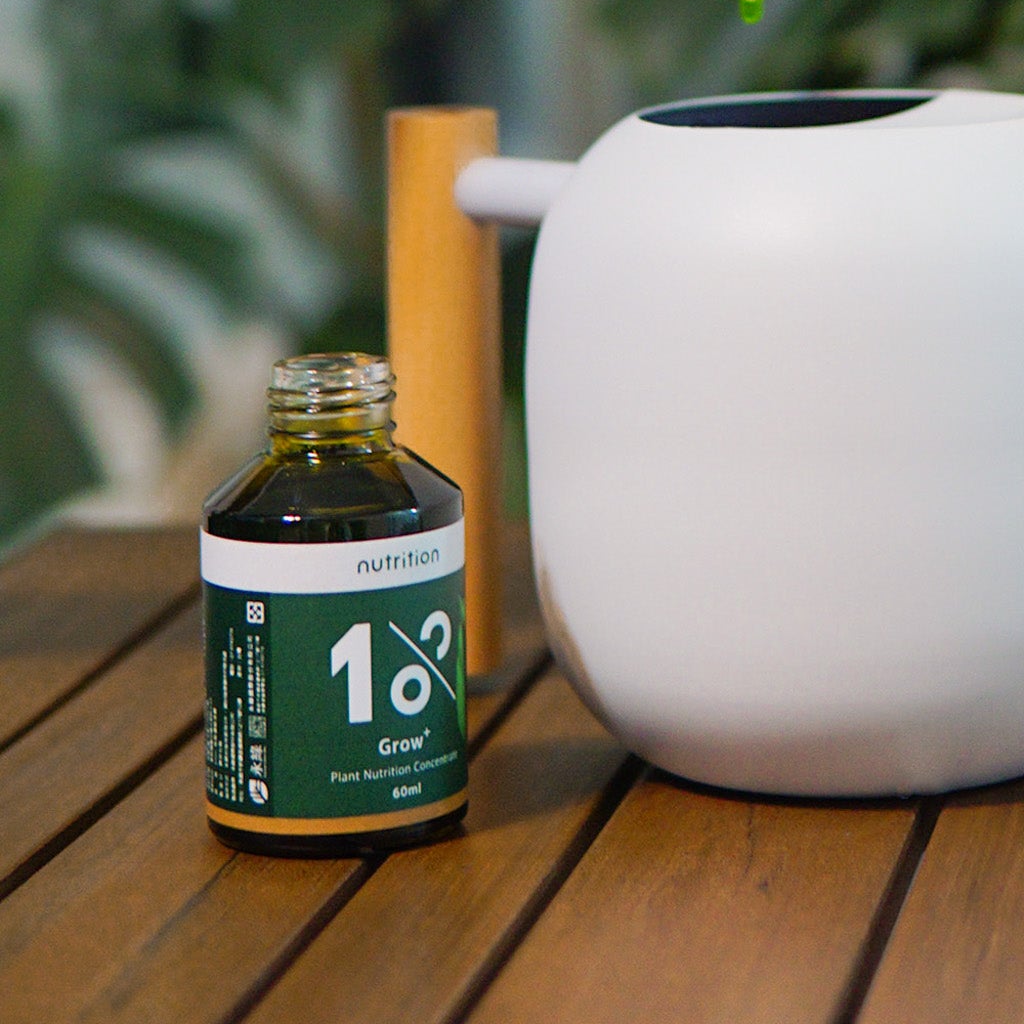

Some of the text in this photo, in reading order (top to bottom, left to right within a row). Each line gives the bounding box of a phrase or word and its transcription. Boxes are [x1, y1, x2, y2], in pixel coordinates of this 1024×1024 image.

[357, 548, 440, 574] nutrition
[330, 770, 361, 784] Plant
[363, 764, 411, 780] Nutrition
[392, 782, 422, 799] 60ml
